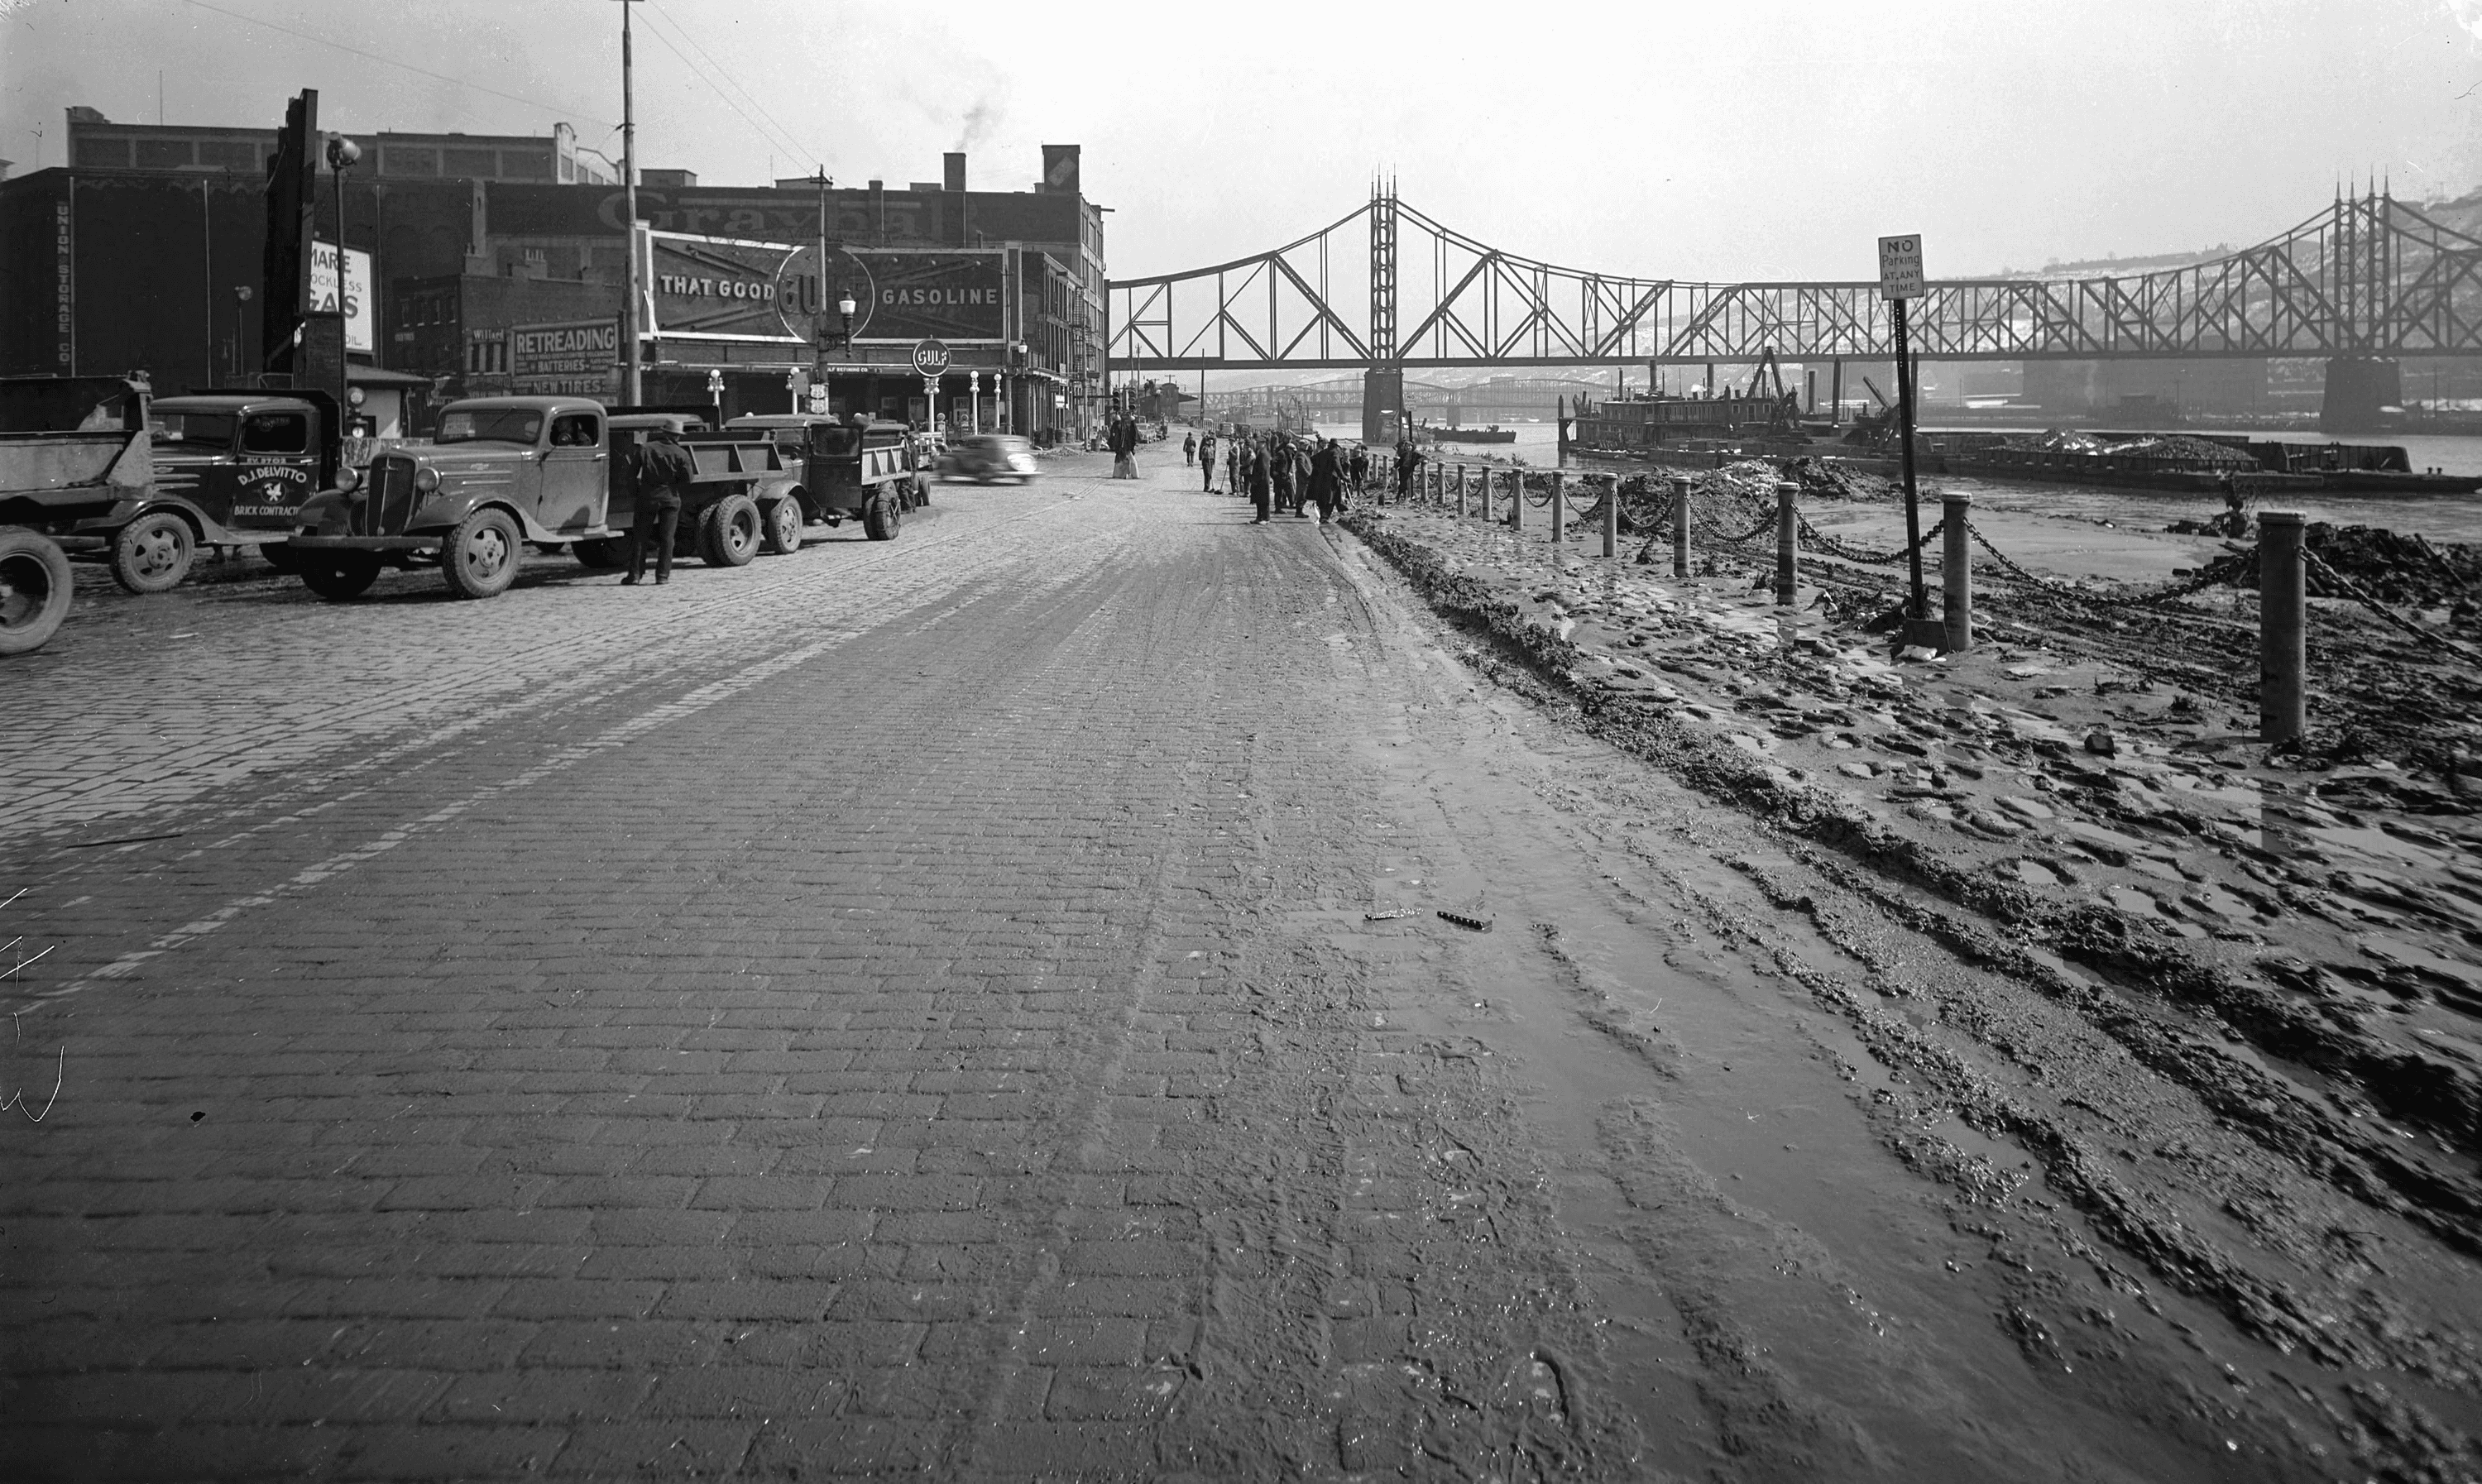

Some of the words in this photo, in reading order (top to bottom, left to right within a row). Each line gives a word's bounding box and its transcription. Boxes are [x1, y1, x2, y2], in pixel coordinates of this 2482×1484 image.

[57, 205, 69, 254] UNION
[1887, 240, 1914, 253] NO
[1882, 255, 1919, 268] Parking
[1883, 272, 1895, 281] AT
[1900, 270, 1920, 280] ANY
[661, 275, 712, 297] THAT
[718, 280, 775, 300] GOOD
[1889, 282, 1916, 293] TIME
[58, 264, 69, 333] STORAGE
[882, 288, 998, 305] GASOLINE
[473, 328, 504, 340] Willard
[516, 327, 615, 353] RETREADING
[538, 358, 585, 372] BATTERIES
[918, 350, 947, 366] GULF
[533, 380, 558, 394] NEW
[559, 378, 601, 393] TIRES
[234, 505, 258, 515] BRICK
